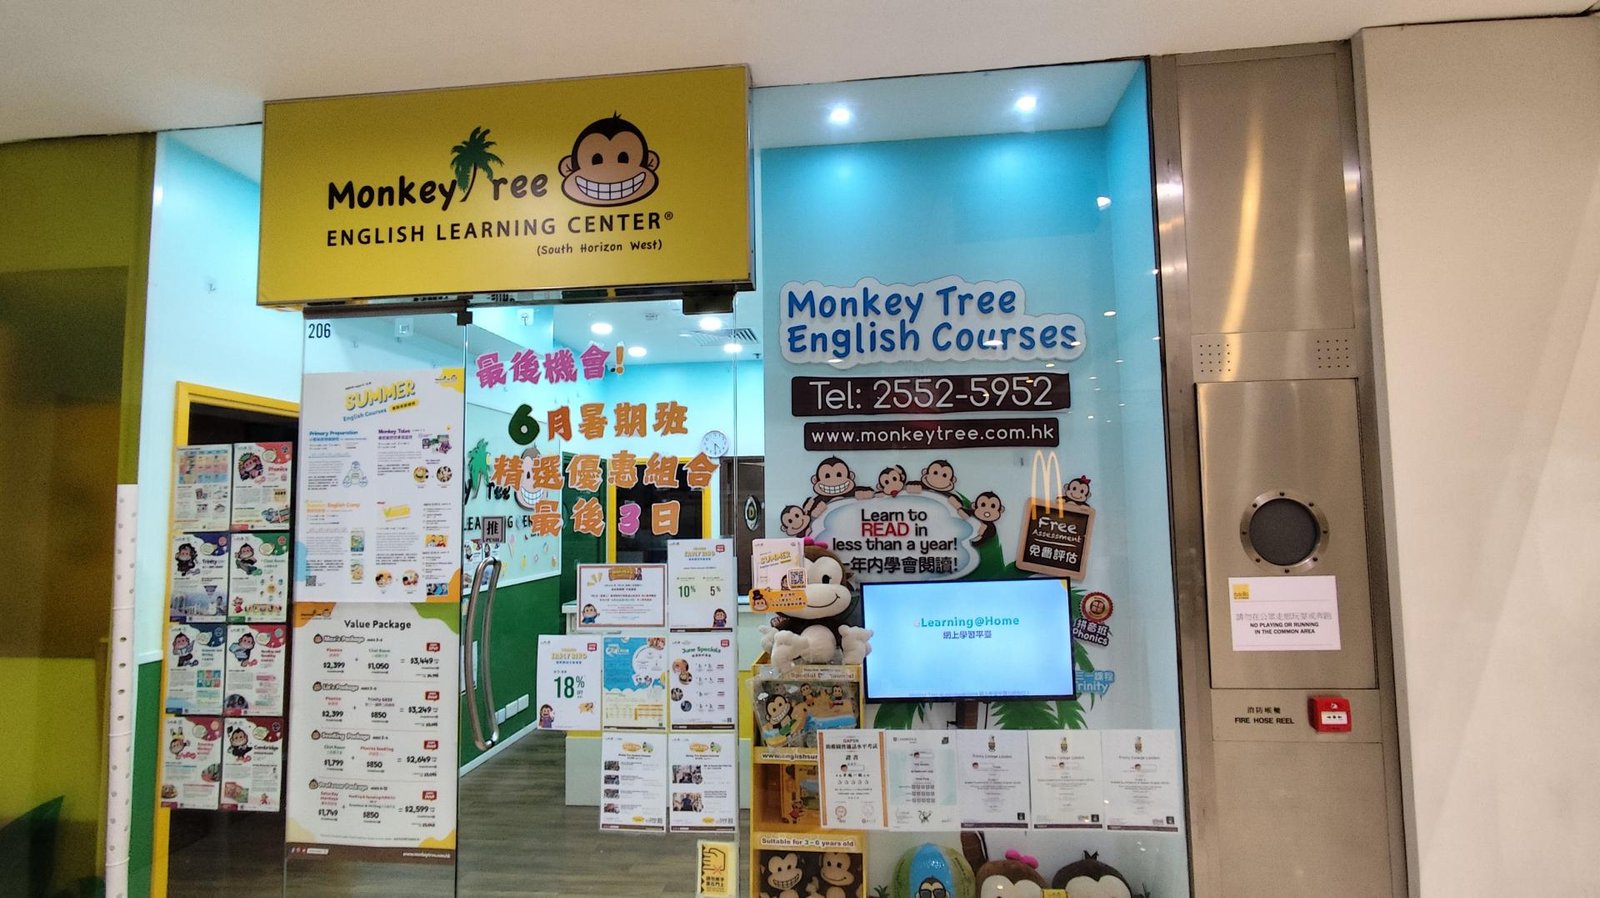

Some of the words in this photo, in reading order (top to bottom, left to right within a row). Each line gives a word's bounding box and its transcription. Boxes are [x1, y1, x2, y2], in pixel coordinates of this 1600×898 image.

[327, 175, 458, 211] Monkey
[326, 223, 425, 247] ENGLISH
[436, 217, 556, 241] LEARNING
[536, 242, 574, 257] (South
[579, 240, 624, 253] Horizon
[630, 239, 663, 253] West)
[788, 287, 924, 323] Monkey
[936, 285, 1016, 316] Tree
[308, 323, 331, 339] 206
[787, 319, 920, 358] English
[932, 322, 1077, 352] Courses
[475, 343, 625, 388] 最後機會!
[345, 380, 416, 411] SUMMER
[809, 381, 862, 410] Tel:
[873, 375, 1053, 409] 2552-5952
[508, 401, 688, 446] 6月暑期班
[811, 424, 1054, 445] www.monkeytree.com.hk
[491, 449, 720, 493] 精選優惠組合
[530, 497, 681, 537] 最後3日
[861, 508, 904, 522] Learn
[908, 508, 928, 522] to
[487, 521, 499, 535] 推
[861, 522, 910, 537] READ
[915, 523, 928, 537] in
[1038, 516, 1077, 535] Free
[1032, 528, 1081, 543] Assessment
[833, 537, 862, 551] less
[865, 538, 902, 551] than
[906, 541, 916, 551] a
[920, 537, 958, 555] year!
[1029, 544, 1078, 564] 免費評估
[344, 619, 371, 629] Value
[372, 620, 412, 631] Package
[1072, 627, 1109, 646] Phonics
[554, 675, 585, 699] 18%
[371, 711, 387, 719] $850
[363, 811, 379, 819] $850
[405, 805, 429, 813] $2,599
[761, 838, 791, 846] Suitable
[821, 839, 840, 848] years
